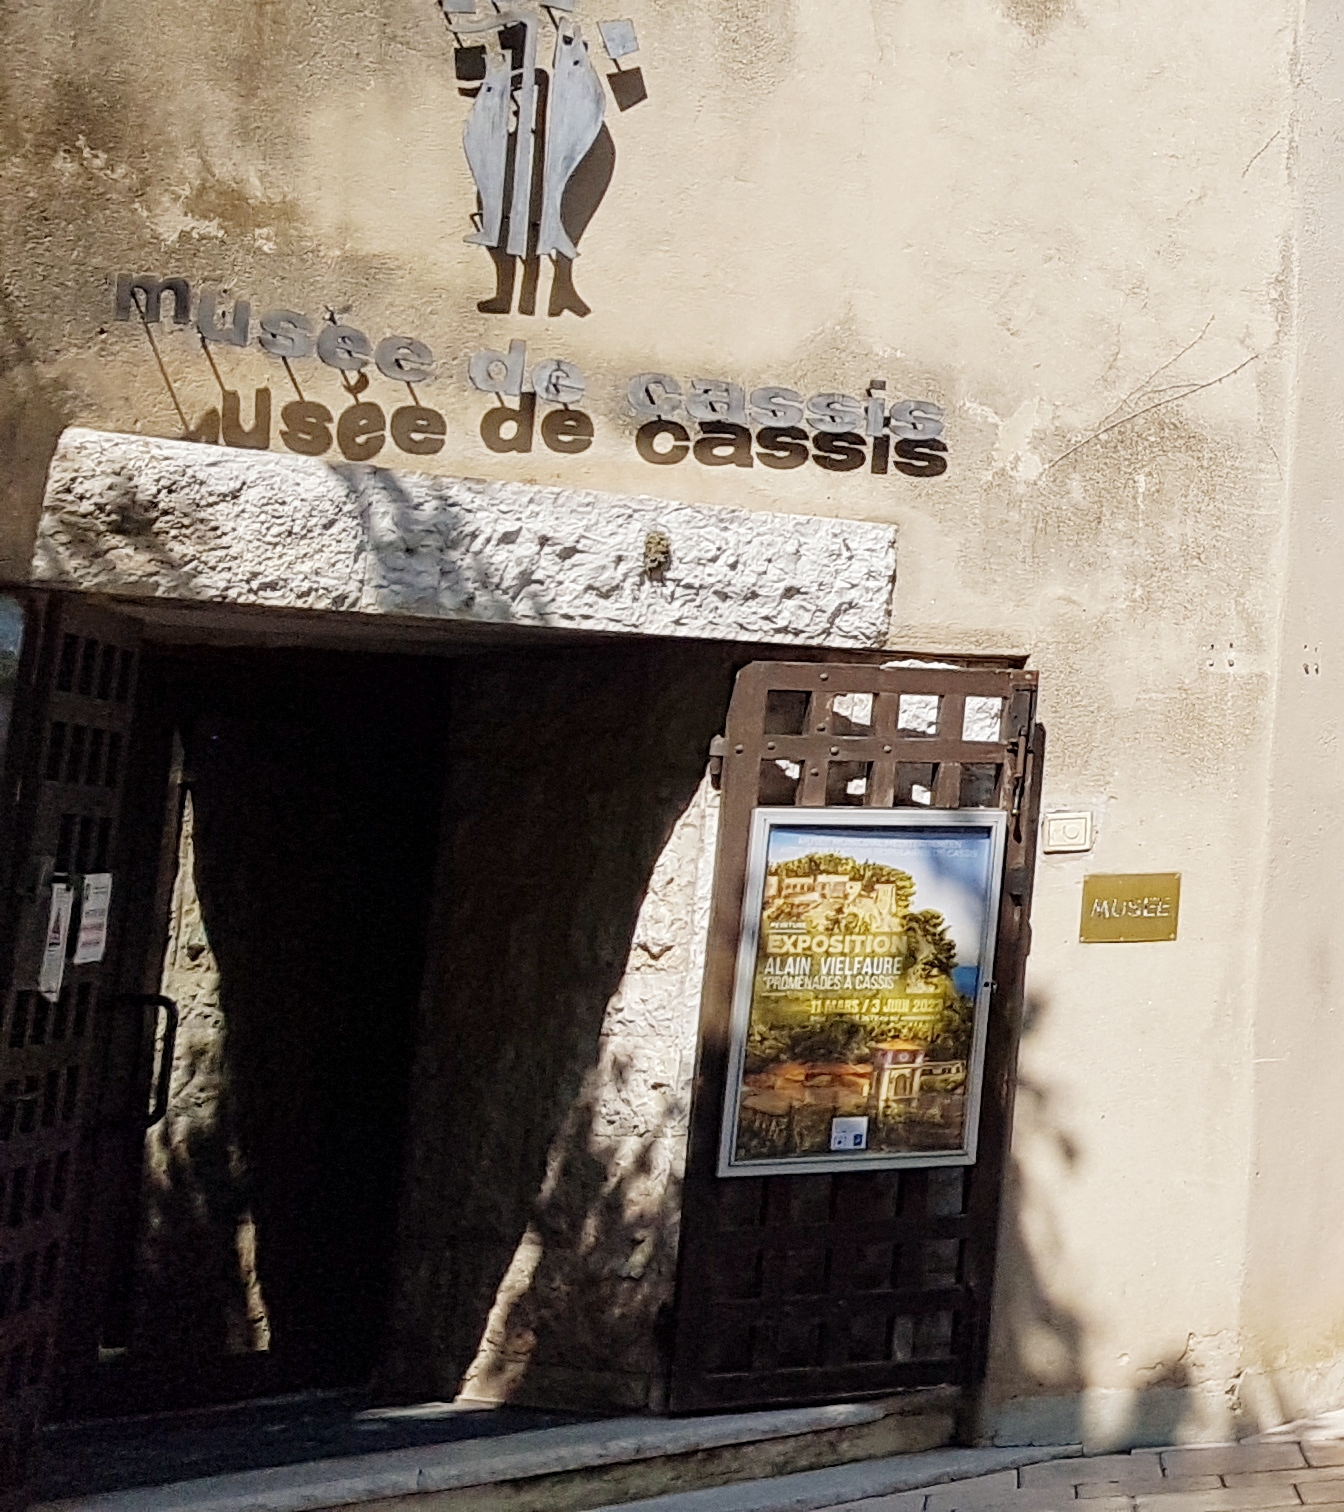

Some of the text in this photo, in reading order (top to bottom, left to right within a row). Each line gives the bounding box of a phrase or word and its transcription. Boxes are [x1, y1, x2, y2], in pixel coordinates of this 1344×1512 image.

[115, 272, 945, 441] musée de cassis
[766, 934, 907, 954] EXPOSITION
[764, 956, 903, 975] ALAIN VIELFAURE
[871, 999, 880, 1013] 3
